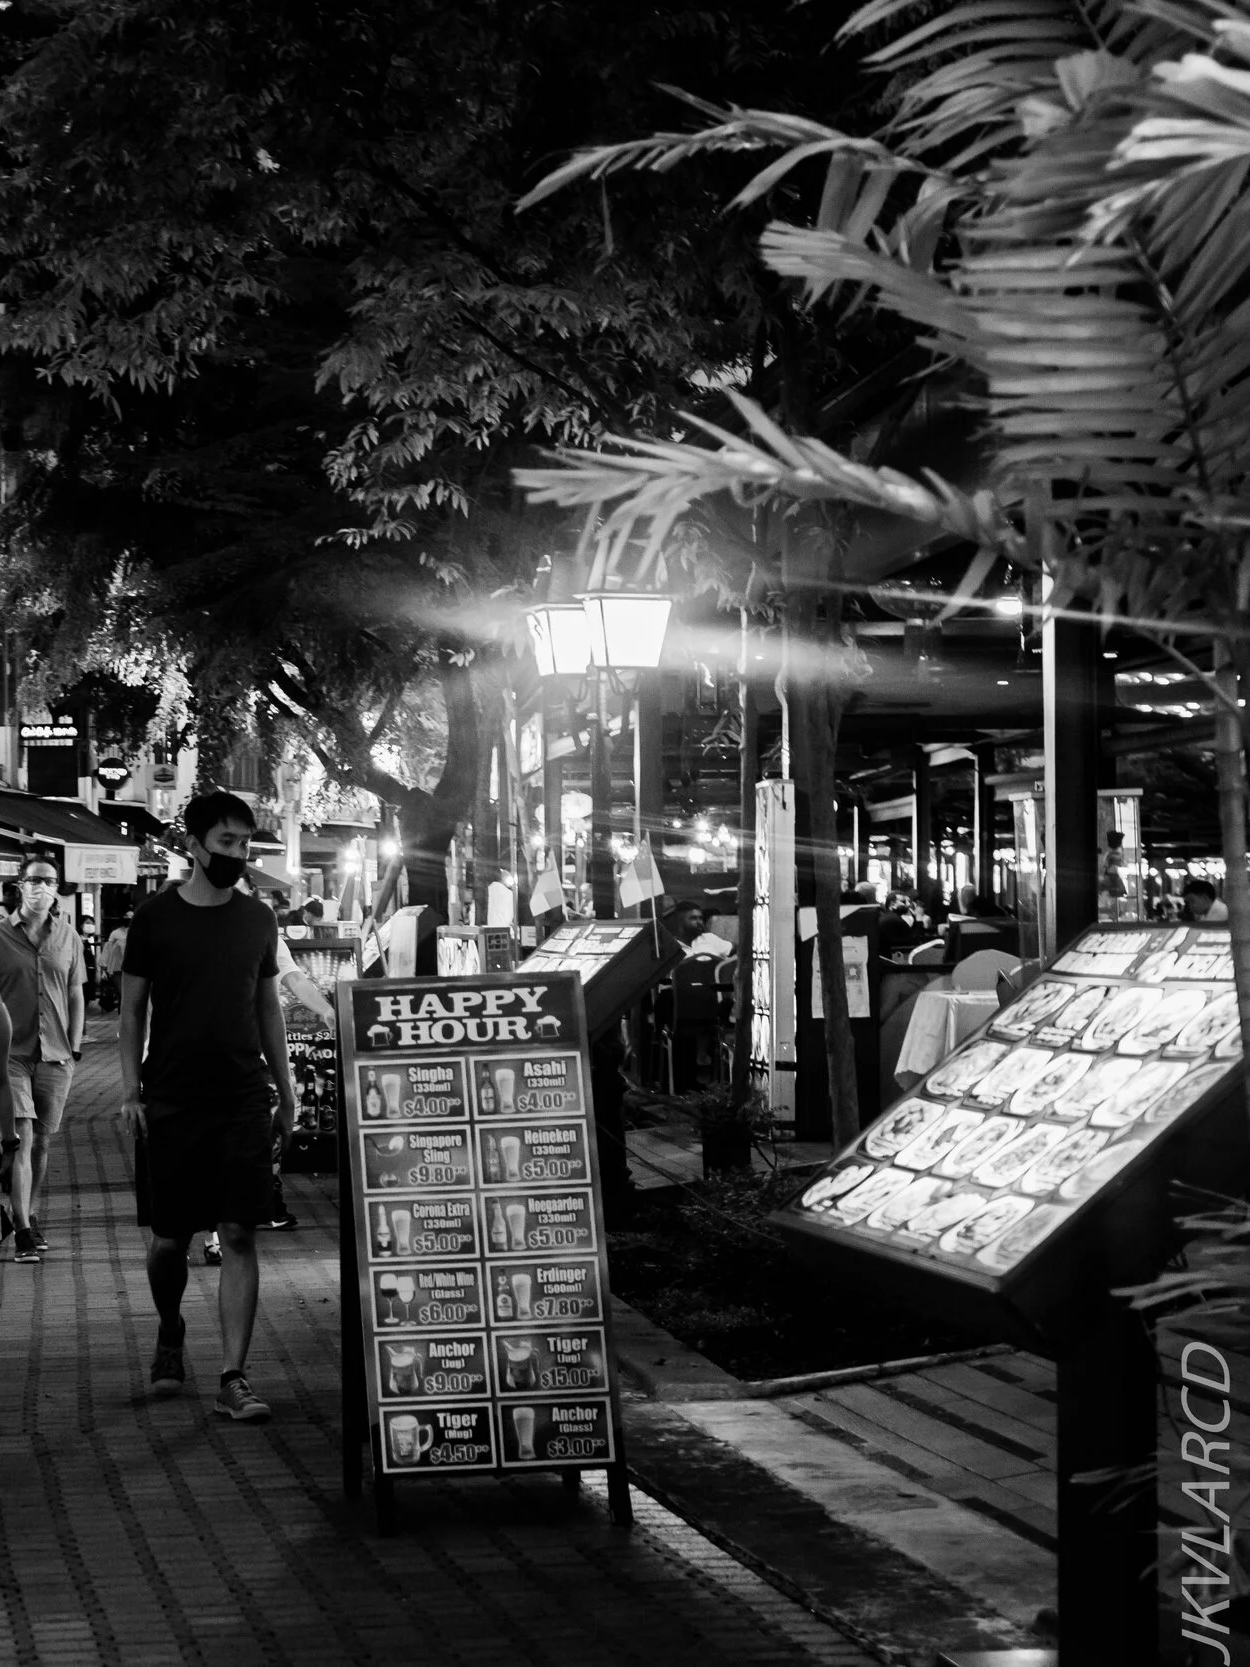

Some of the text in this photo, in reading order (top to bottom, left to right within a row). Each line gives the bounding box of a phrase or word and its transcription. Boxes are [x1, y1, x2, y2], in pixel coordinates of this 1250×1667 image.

[375, 986, 548, 1021] HAPPY
[396, 1016, 532, 1046] HOUR
[408, 1066, 454, 1083] Singha
[523, 1060, 567, 1077] Asahi
[414, 1082, 451, 1093] (330ml)
[527, 1077, 566, 1088] (330ml)
[409, 1134, 462, 1151] Singapore
[524, 1128, 577, 1145] Heineken
[423, 1150, 451, 1164] Sling
[532, 1144, 571, 1156] (330ml)
[413, 1202, 471, 1219] Corona Extra
[528, 1197, 584, 1213] Hoegaarden
[423, 1218, 462, 1229] (330ml)
[538, 1213, 577, 1224] (330ml)
[419, 1272, 475, 1289] Red/White Wine
[536, 1267, 587, 1284] Erdinger
[431, 1288, 465, 1299] (Glass)
[543, 1283, 582, 1294] (500ml)
[429, 1342, 476, 1358] Anchor
[547, 1337, 588, 1354] Tiger
[441, 1359, 465, 1370] (Jug)
[557, 1353, 581, 1364] (Jug)
[436, 1412, 478, 1429] Tiger
[552, 1406, 599, 1422] Anchor
[445, 1428, 472, 1440] (Mug)
[559, 1422, 593, 1433] (Glass)
